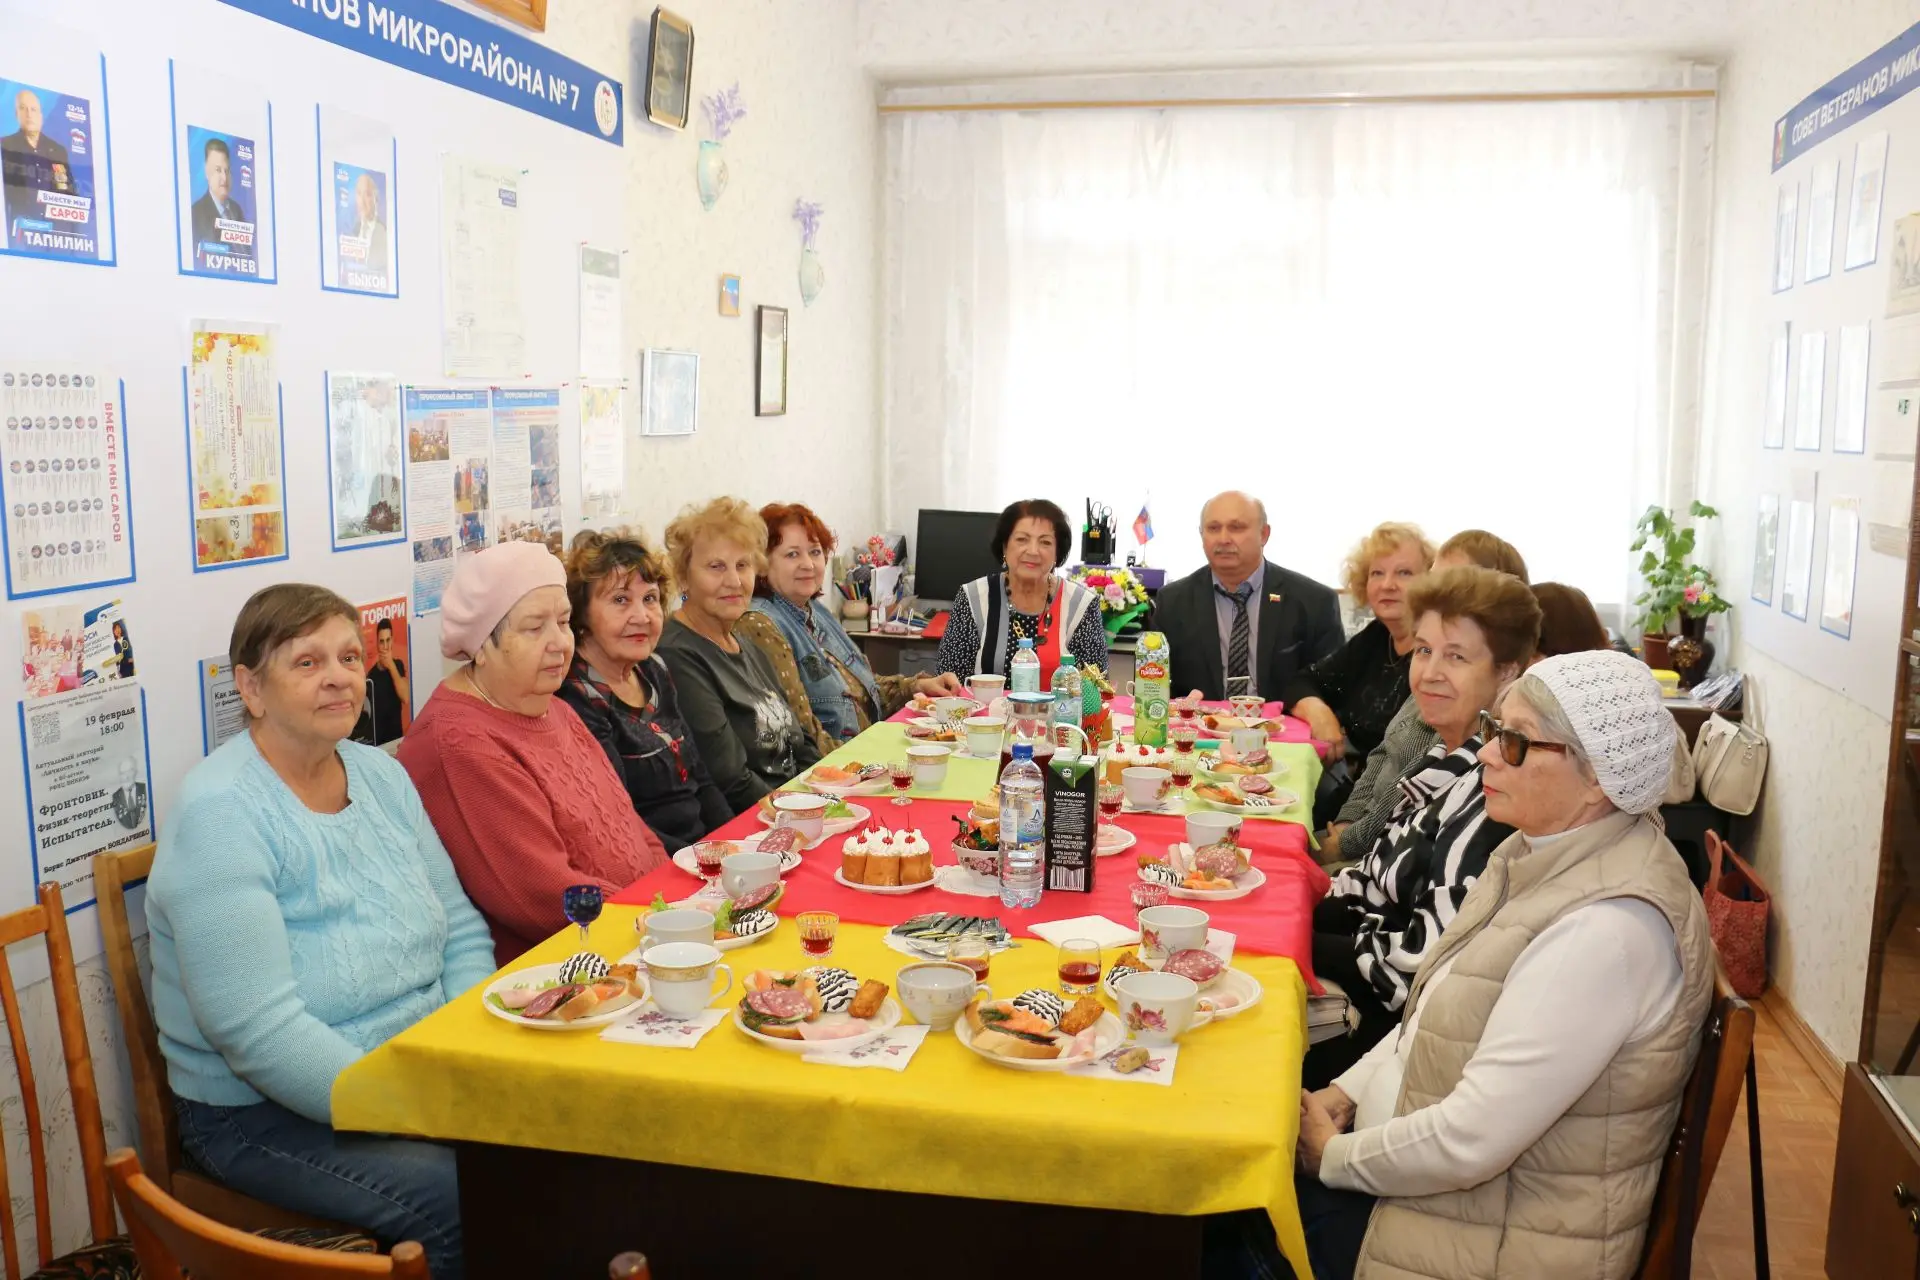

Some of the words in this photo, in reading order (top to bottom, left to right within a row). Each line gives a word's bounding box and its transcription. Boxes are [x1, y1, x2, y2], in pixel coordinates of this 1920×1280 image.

[368, 2, 545, 98] МИКРОРАЙОНА
[549, 75, 568, 105] №
[570, 85, 580, 111] 7
[1792, 107, 1820, 146] СОВЕТ
[1820, 66, 1889, 128] ВЕТЕРАНОВ
[42, 192, 72, 205] Вместе
[73, 199, 87, 207] мы
[50, 206, 87, 221] САРОВ
[24, 231, 94, 253] ТАПИЛИН
[224, 231, 251, 244] САРОВ
[206, 253, 257, 274] КУРЧЕВ
[104, 402, 117, 461] ВМЕСТЕ
[108, 463, 118, 491] МЫ
[110, 493, 122, 543] САРОВ
[361, 601, 406, 627] ГОВОРИ
[85, 715, 96, 727] 19
[98, 706, 136, 723] февраля
[100, 721, 125, 736] 18:00
[39, 788, 109, 816] Фронтовик.
[1055, 790, 1086, 798] VINOGOR
[41, 818, 116, 849] Испытатель.
[43, 861, 64, 874] Борис
[107, 828, 150, 849] БОНДАРЕНКО
